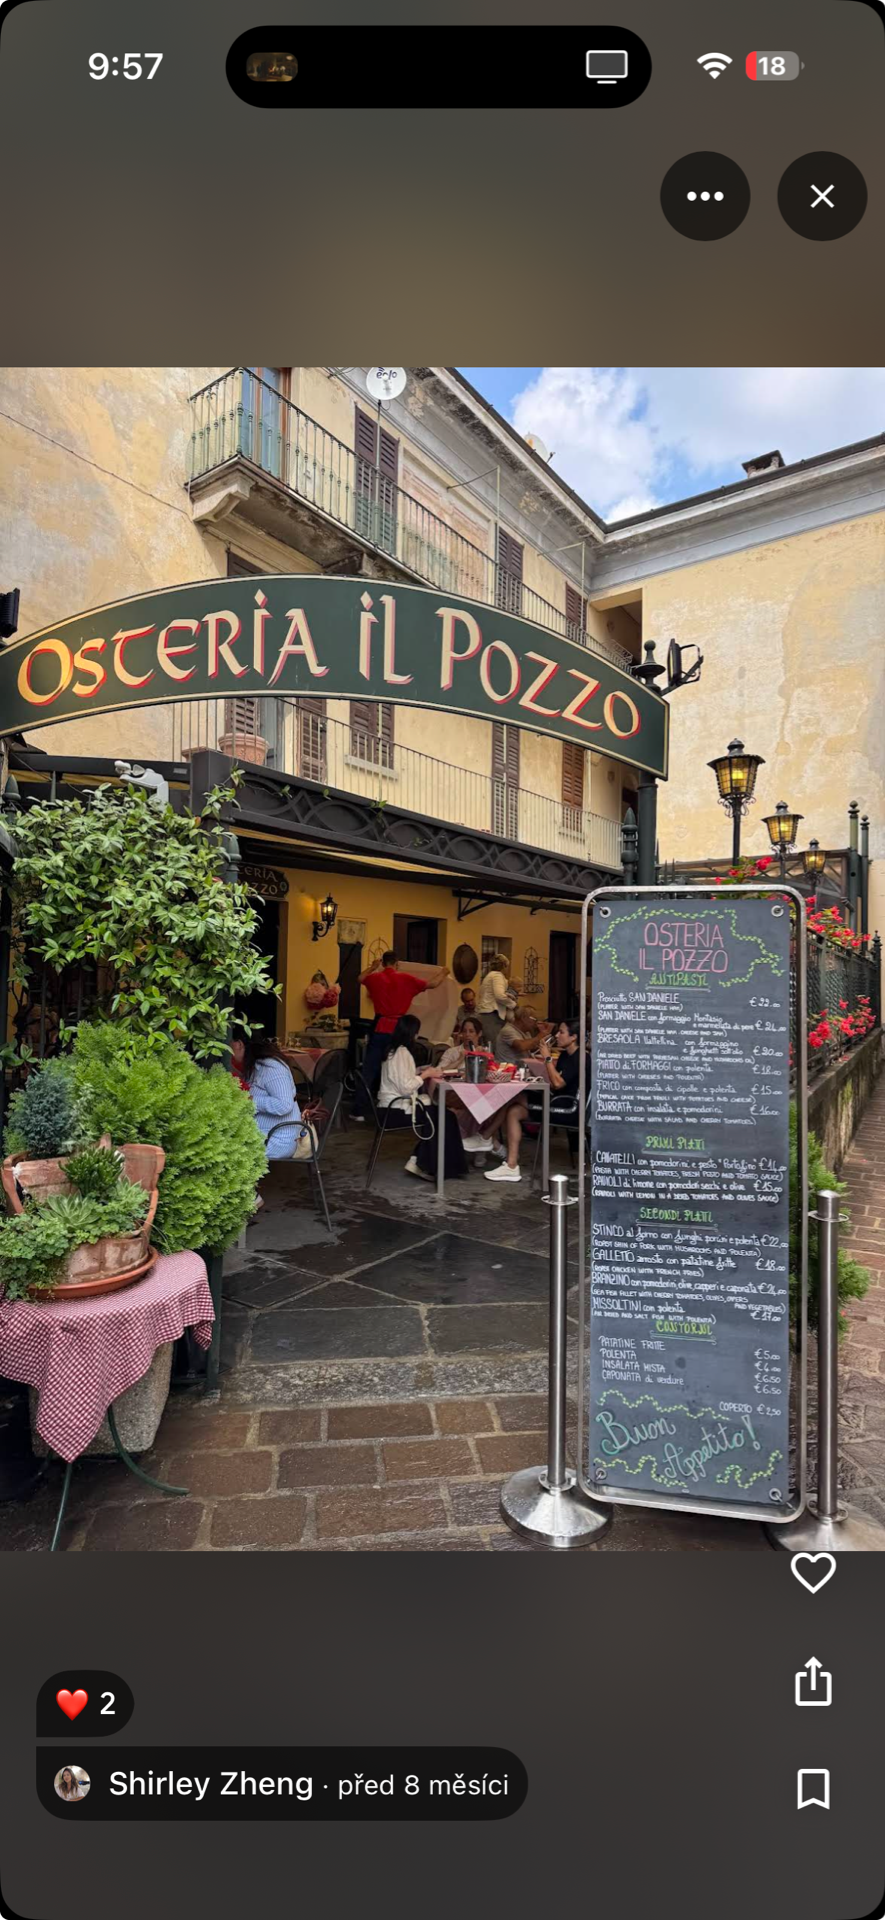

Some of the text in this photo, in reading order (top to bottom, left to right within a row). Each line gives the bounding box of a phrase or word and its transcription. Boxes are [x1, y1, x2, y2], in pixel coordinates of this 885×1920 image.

[434, 606, 642, 740] POZZO
[644, 922, 724, 948] OSTERIA
[639, 948, 729, 973] IL POZZO
[649, 972, 709, 987] ANTIPASTI
[628, 992, 646, 1002] SAN
[646, 993, 680, 1003] DANIELE
[598, 1010, 613, 1020] SAN
[615, 1011, 647, 1021] DANIELE
[657, 1012, 691, 1024] formaggio
[694, 1013, 723, 1023] Montasio
[732, 1022, 741, 1030] di
[741, 1024, 755, 1032] pere
[597, 1033, 641, 1044] BRESAOLA
[643, 1035, 678, 1046] Valtellina
[597, 1059, 621, 1070] PIATTO
[623, 1061, 631, 1070] di
[630, 1060, 671, 1071] FORMAGGI
[685, 1063, 714, 1073] polenta
[597, 1080, 620, 1091] FRICO
[634, 1083, 664, 1093] composta
[664, 1084, 673, 1092] di
[677, 1083, 699, 1094] cipolle
[709, 1084, 738, 1095] polenta
[597, 1100, 632, 1112] BURRATA
[647, 1102, 675, 1113] insalata
[682, 1105, 724, 1115] pomodorini
[645, 1135, 705, 1151] PRIMI PIATTI
[650, 1158, 690, 1169] pomodorini
[698, 1158, 718, 1171] pesto
[593, 1175, 622, 1187] RAVIOLI
[623, 1179, 632, 1188] di
[632, 1178, 655, 1188] limone
[656, 1181, 667, 1189] con
[668, 1179, 700, 1191] pomodori
[701, 1181, 721, 1190] secchi
[729, 1182, 746, 1191] olive
[640, 1206, 714, 1223] SECONDI PIATTI
[592, 1223, 625, 1237] STINCO
[626, 1227, 635, 1238] al
[635, 1226, 659, 1242] forno
[674, 1229, 703, 1245] funghi
[704, 1235, 728, 1244] porcini
[735, 1234, 760, 1246] polenta
[640, 1242, 656, 1250] PORK
[592, 1248, 635, 1263] GALLETTO
[636, 1253, 664, 1263] arrosto
[681, 1255, 715, 1267] patatine
[715, 1257, 737, 1271] fritte
[591, 1271, 630, 1286] BRANZINO
[726, 1282, 759, 1294] caponata
[592, 1296, 686, 1313] MISSOLTINI con polenta
[655, 1319, 713, 1335] CONTORNI
[599, 1336, 666, 1351] PATATINE FRITTE
[600, 1348, 637, 1360] POLENTA
[602, 1359, 666, 1374] INSALATA MISTA
[602, 1370, 685, 1386] CAPONATA di verdure
[719, 1401, 753, 1413] COPERTO
[596, 1411, 676, 1455] Buon
[662, 1414, 762, 1482] Appetito!
